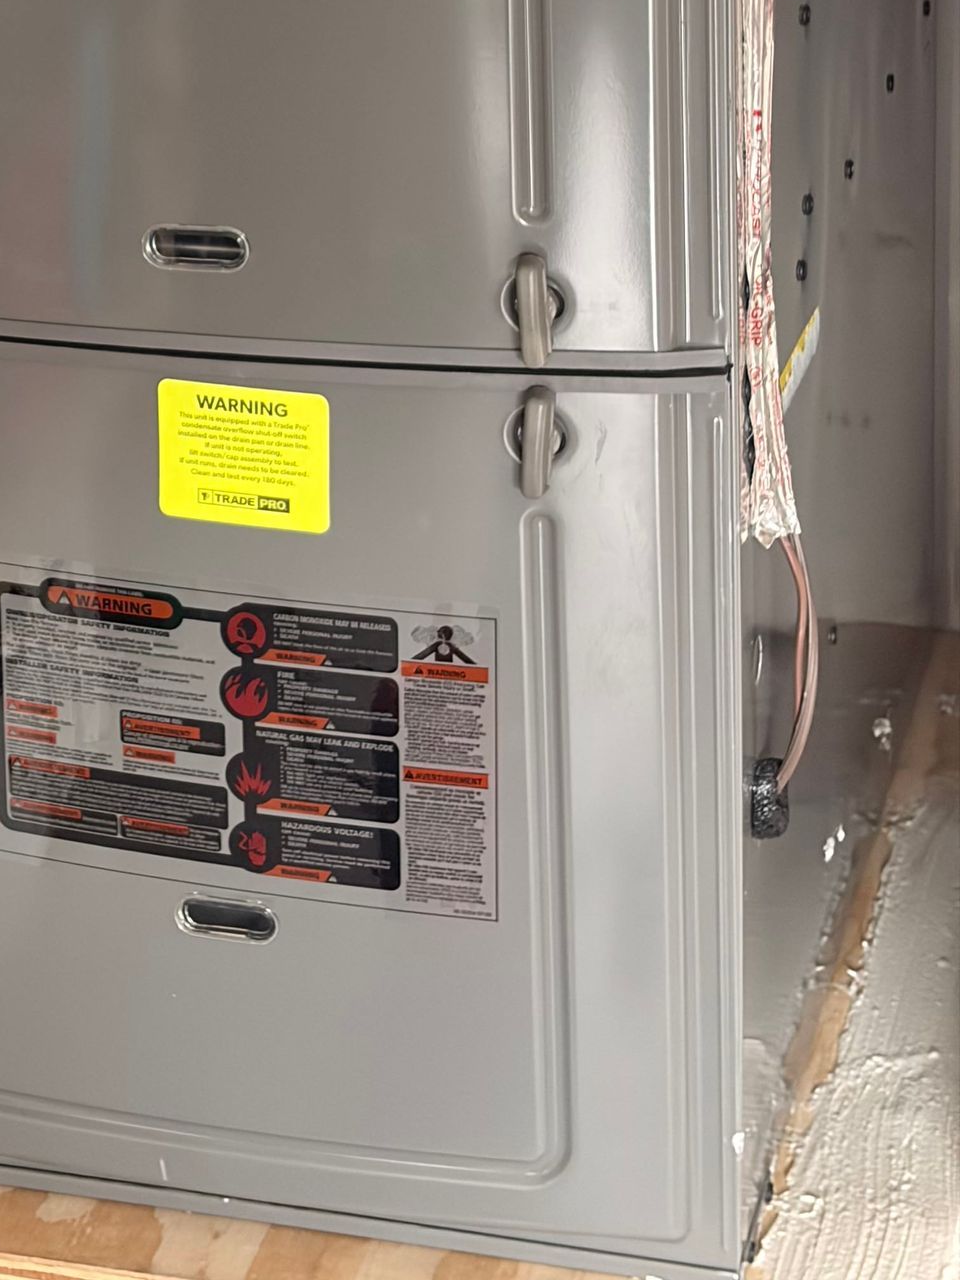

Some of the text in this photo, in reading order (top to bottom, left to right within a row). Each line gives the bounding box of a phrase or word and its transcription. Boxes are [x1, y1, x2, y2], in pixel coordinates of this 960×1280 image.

[195, 394, 289, 417] WARNING
[182, 422, 221, 431] condensate
[216, 416, 249, 426] equipped
[178, 431, 207, 439] installed
[238, 464, 259, 472] needs
[191, 469, 211, 477] Clean
[241, 476, 260, 484] every
[215, 494, 287, 510] TRADE PRO
[75, 592, 154, 618] WARNING
